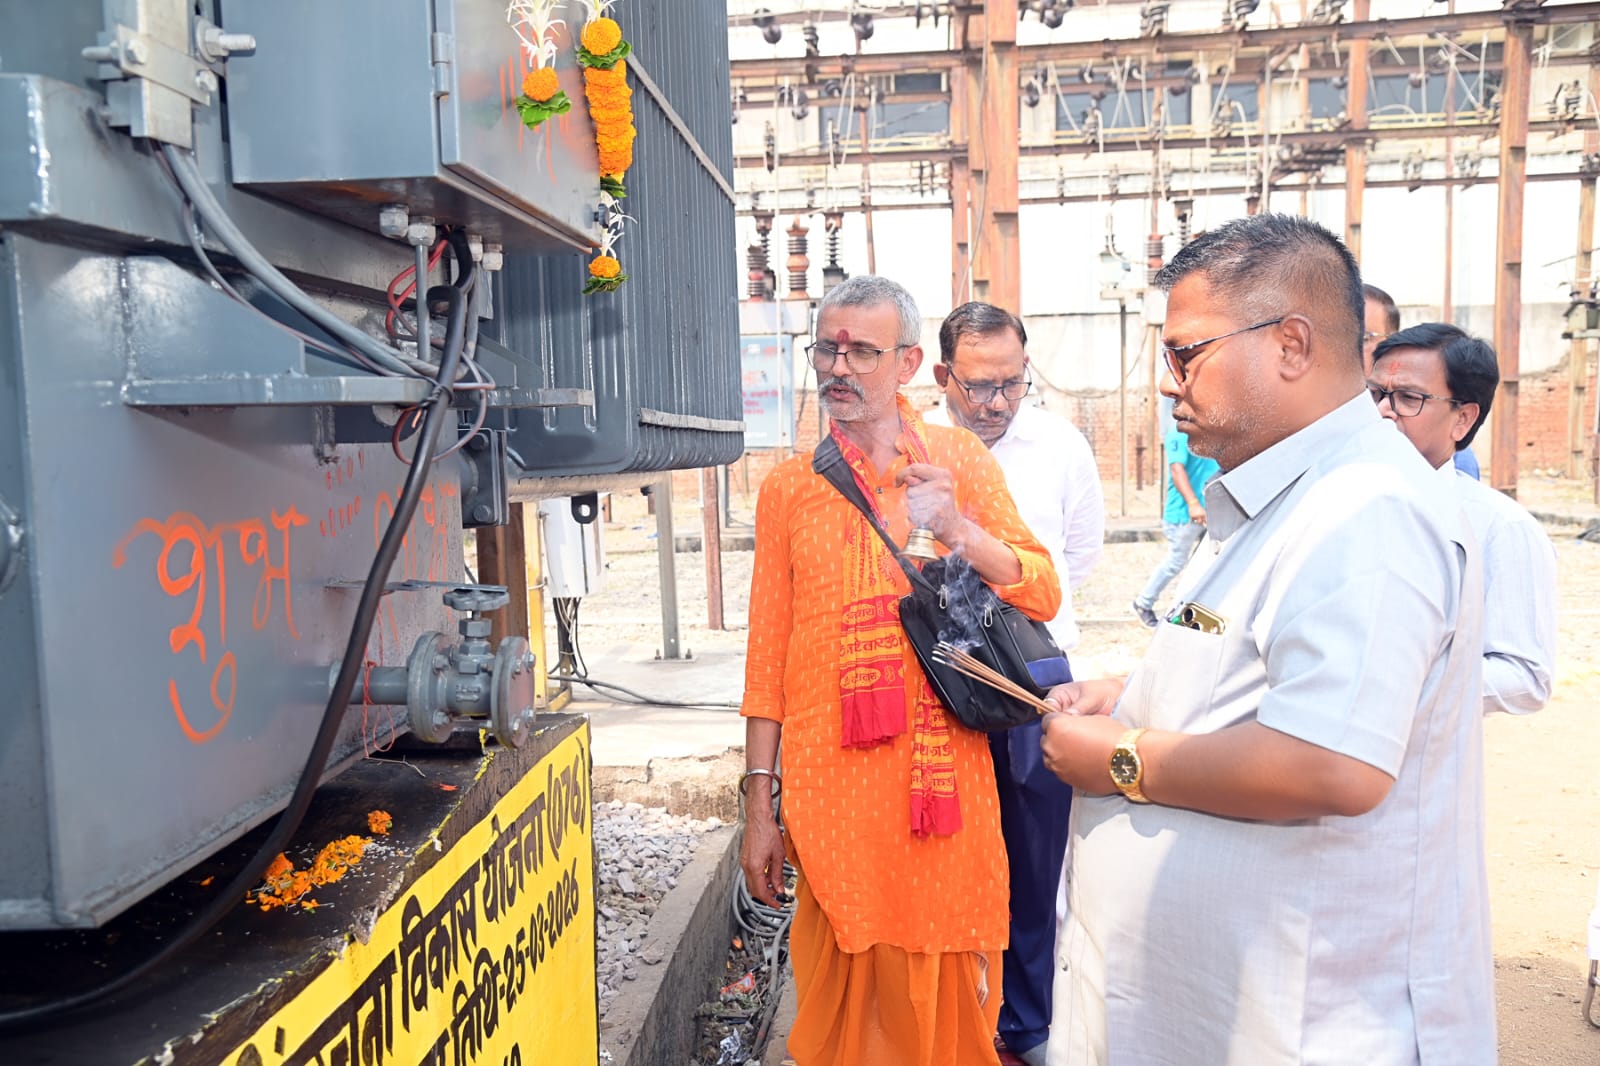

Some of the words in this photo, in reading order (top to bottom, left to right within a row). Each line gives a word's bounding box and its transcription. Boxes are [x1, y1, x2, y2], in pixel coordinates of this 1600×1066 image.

[399, 858, 481, 1034] विकास
[482, 791, 546, 924] योजना
[547, 736, 586, 862] (076)
